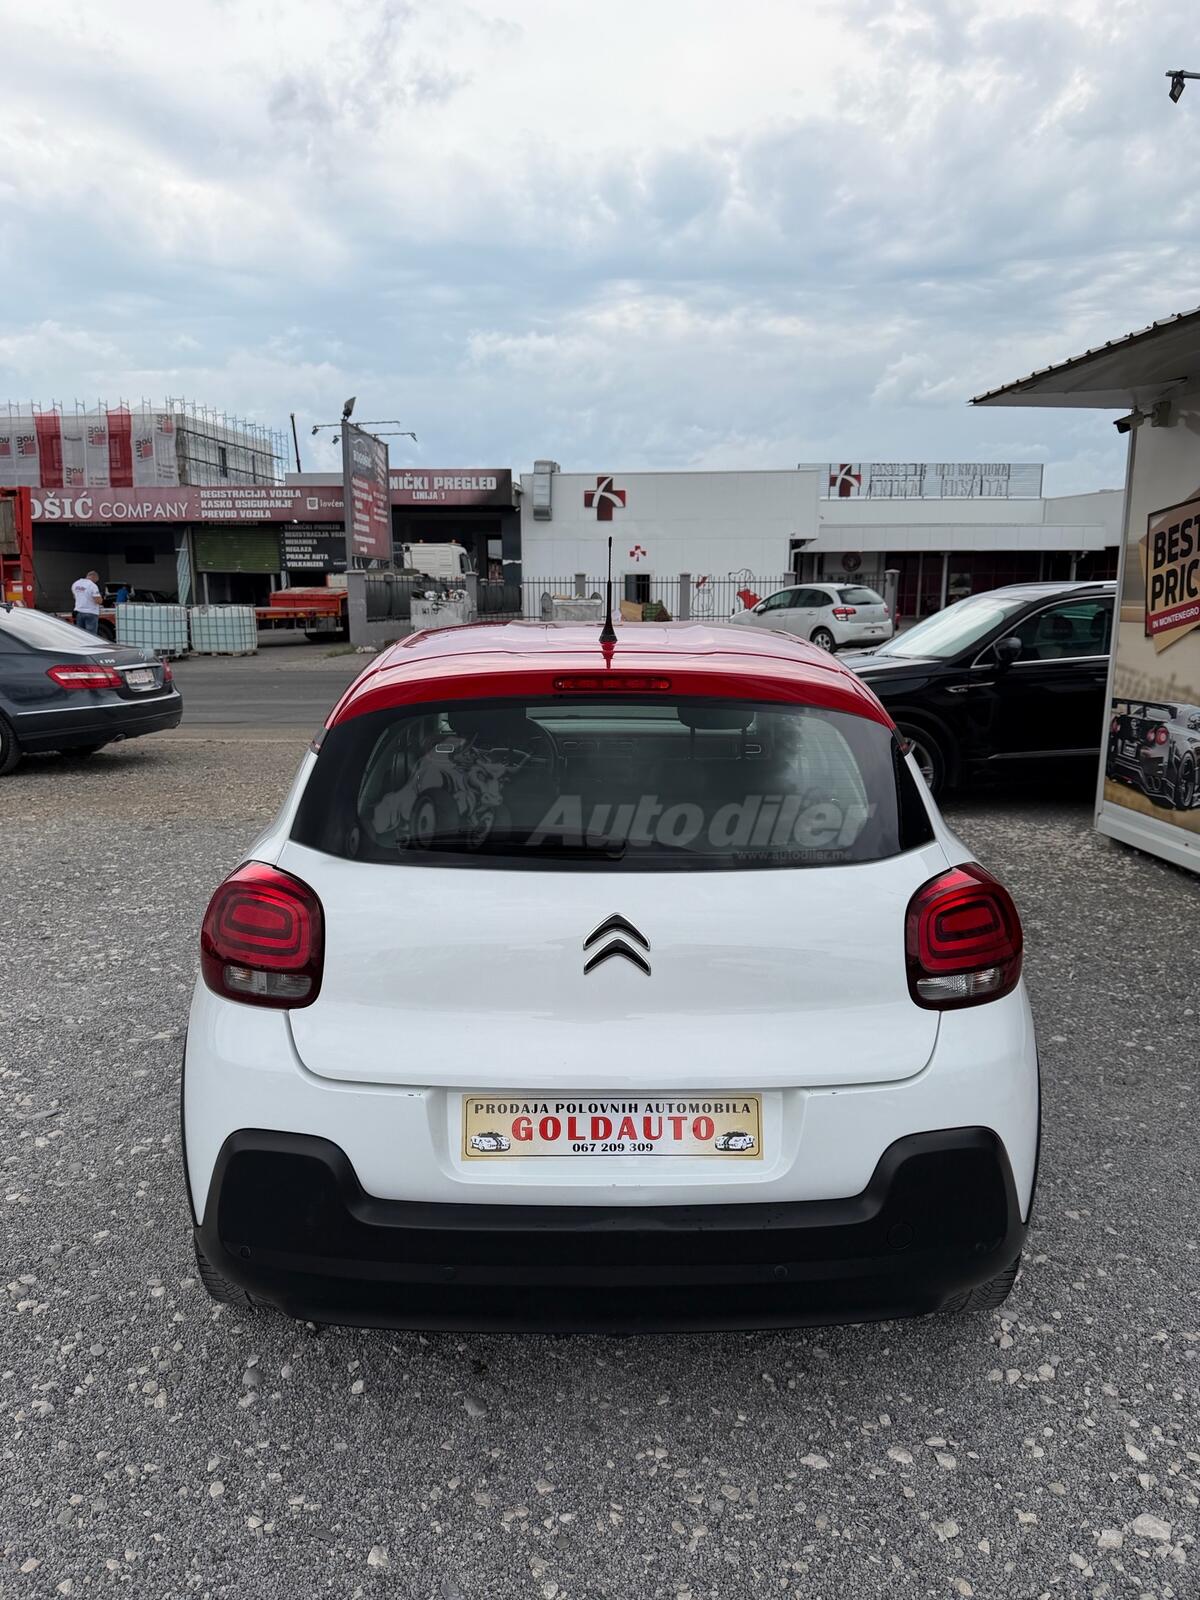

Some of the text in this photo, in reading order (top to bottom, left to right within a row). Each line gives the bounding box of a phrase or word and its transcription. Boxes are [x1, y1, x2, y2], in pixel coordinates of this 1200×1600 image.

[433, 476, 496, 490] PREGLED
[200, 490, 302, 498] REGISTRACIJA VOZILA
[412, 491, 446, 500] LINIJA 1
[201, 499, 293, 508] KASKO OSIGURANJE
[99, 502, 188, 518] COMPANY
[202, 510, 271, 518] PREVOD VOZILA
[1152, 606, 1200, 629] IN MONTENEGRO
[474, 1102, 751, 1114] PRODAJA POLOVNIH AUTOMOBILA
[511, 1115, 715, 1142] GOLDAUTO
[572, 1142, 654, 1153] 067 209 309
